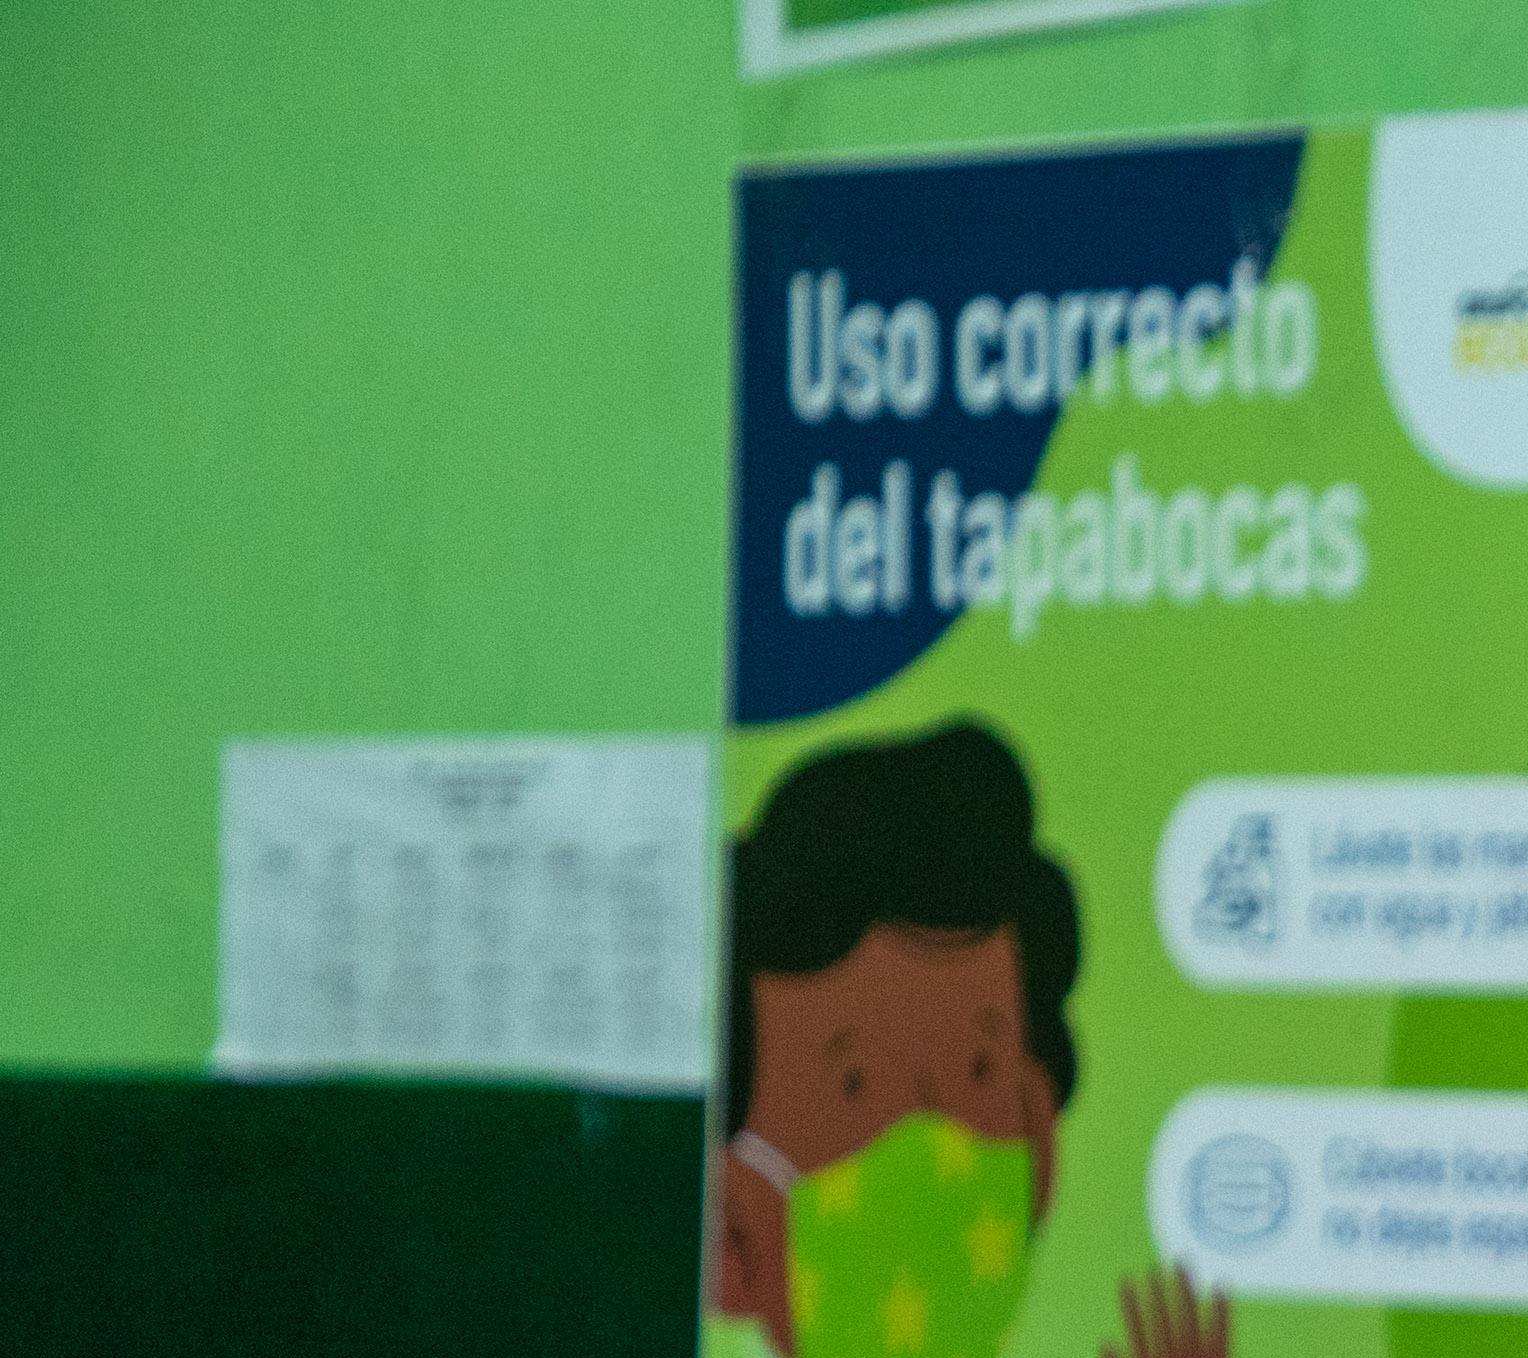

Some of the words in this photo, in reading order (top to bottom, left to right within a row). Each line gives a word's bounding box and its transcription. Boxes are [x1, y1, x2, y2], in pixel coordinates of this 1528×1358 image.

[789, 268, 939, 422] Uso
[957, 254, 1317, 416] correcto
[785, 456, 911, 615] del
[928, 452, 1369, 642] tapabocas
